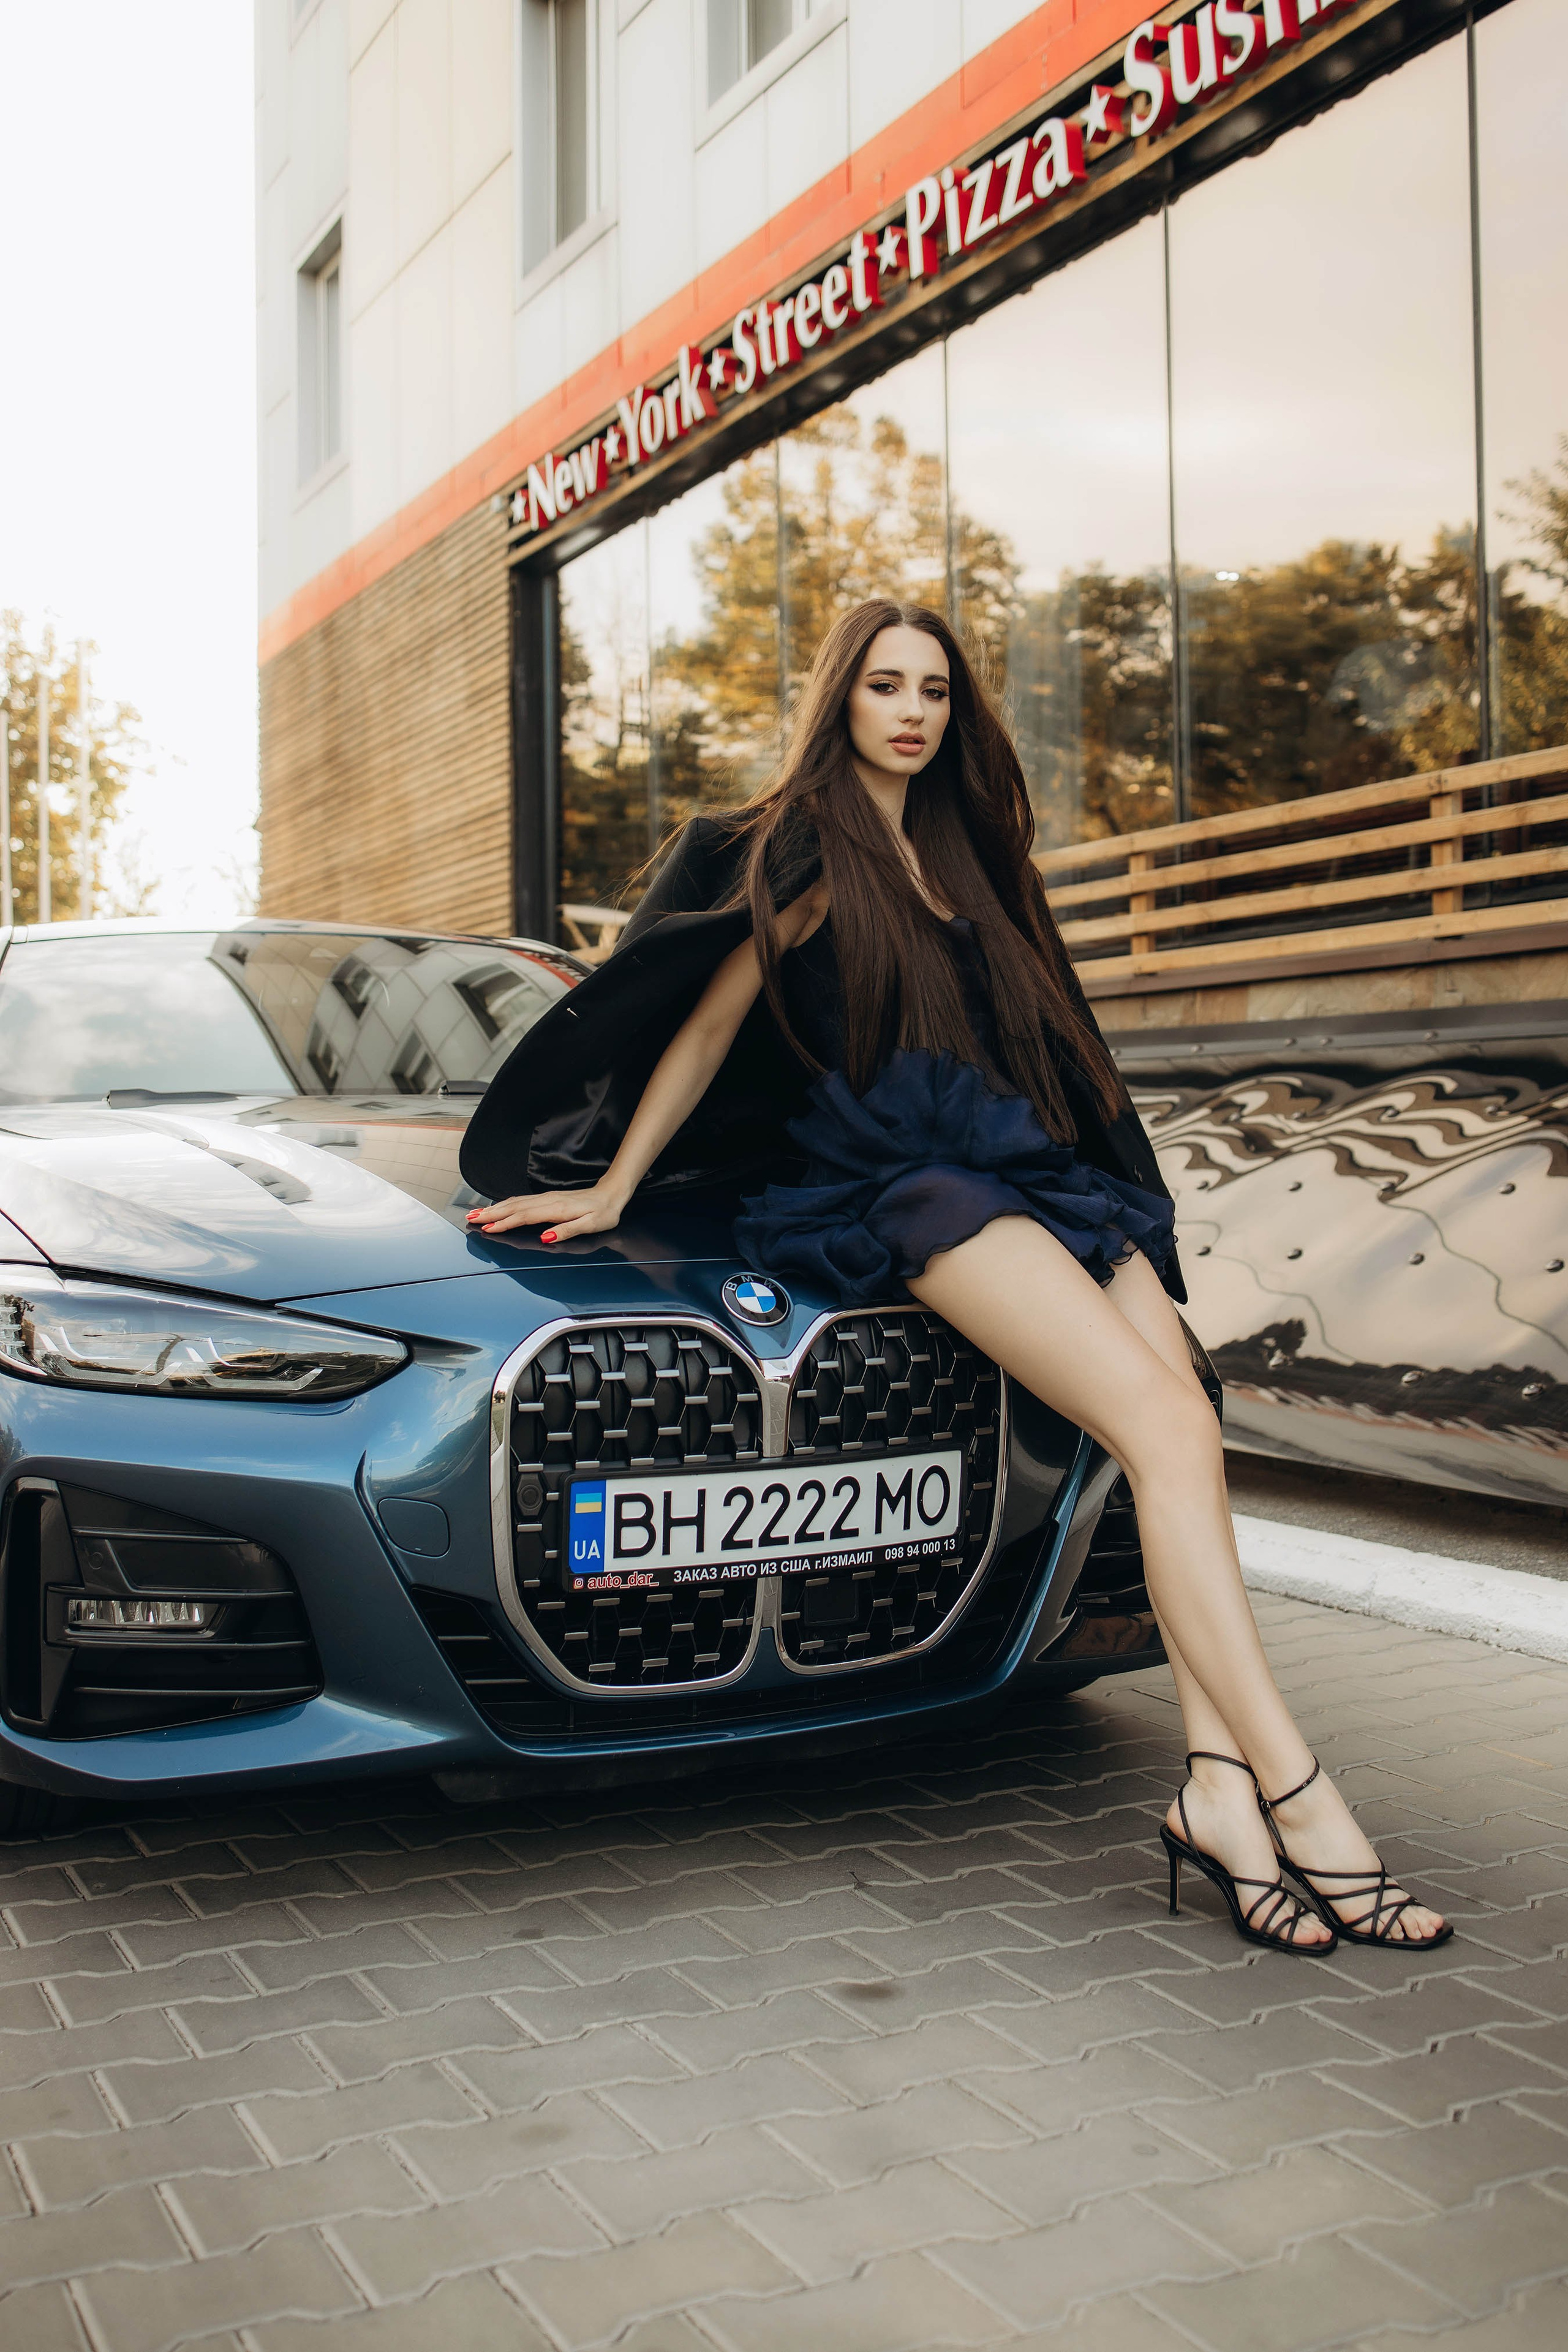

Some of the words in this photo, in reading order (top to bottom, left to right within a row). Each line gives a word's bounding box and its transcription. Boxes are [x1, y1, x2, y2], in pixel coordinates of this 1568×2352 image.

[527, 437, 600, 531] New
[616, 344, 706, 466] York
[733, 230, 873, 393] Street
[904, 118, 1074, 279] Pizza
[1123, 0, 1337, 137] Sus
[725, 1275, 776, 1291] BMW
[613, 1488, 706, 1559] BH
[721, 1476, 861, 1550] 2222
[875, 1464, 951, 1534] MO
[573, 1540, 601, 1560] UA
[884, 1547, 904, 1560] 098
[907, 1544, 919, 1557] 94
[922, 1541, 941, 1555] 000
[944, 1538, 956, 1551] 13
[674, 1567, 718, 1582] ЗАКАЗ
[721, 1563, 757, 1578] АВТО
[760, 1562, 777, 1575] ИЗ
[780, 1558, 811, 1572] США
[815, 1551, 873, 1569] г.ИЗМАИЛ
[587, 1571, 660, 1589] auto_dar_
